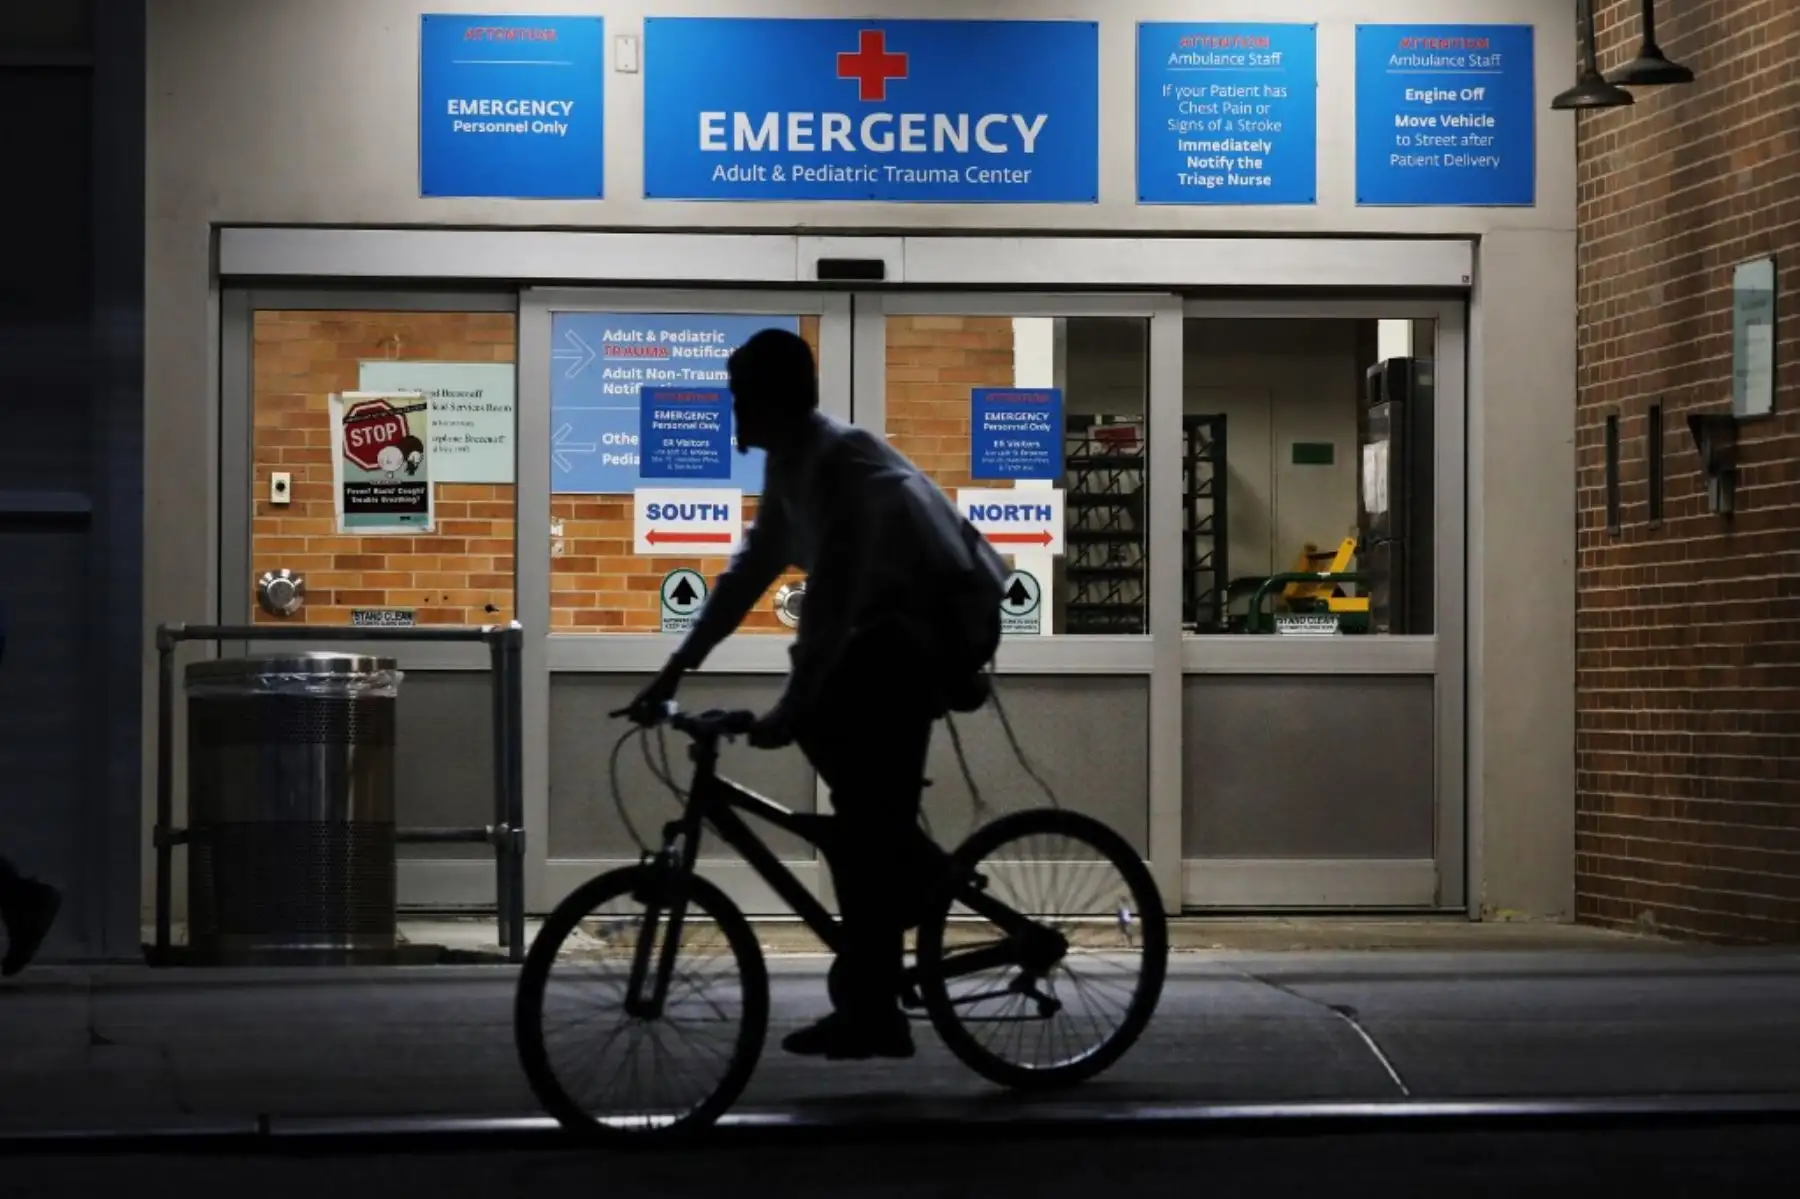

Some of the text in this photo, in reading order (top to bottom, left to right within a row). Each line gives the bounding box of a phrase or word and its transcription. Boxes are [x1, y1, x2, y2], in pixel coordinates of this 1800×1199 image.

[1168, 51, 1283, 66] Ambulance Staff
[1389, 53, 1502, 67] Ambulance Staff
[1162, 84, 1287, 100] If your Patient has
[1405, 87, 1485, 104] Engine Off
[447, 99, 574, 117] EMERGENCY
[1179, 101, 1271, 115] Chest Pain or
[453, 120, 568, 137] Personnel Only
[1167, 118, 1282, 134] Signs of a Stroke
[1395, 113, 1495, 128] Move Vehicle
[699, 111, 1048, 153] EMERGENCY
[1396, 132, 1494, 146] to Street after
[1178, 138, 1272, 155] Immediately
[1187, 155, 1263, 171] Notify the
[1390, 153, 1500, 170] Patient Delivery
[712, 164, 1032, 184] Adult & Pediatric Trauma Center
[1177, 172, 1271, 188] Triage Nurse
[602, 329, 725, 343] Adult & Pediatric
[604, 343, 738, 358] TRAUMA Notificat
[602, 367, 730, 380] Adult Non-Traum
[654, 410, 719, 421] EMERGENCY
[984, 411, 1050, 421] EMERGENCY
[652, 421, 697, 430] Personnel
[350, 422, 397, 448] STOP
[602, 432, 639, 446] Othe
[602, 452, 640, 466] Pedia
[646, 503, 729, 521] SOUTH
[969, 503, 1052, 521] NORTH
